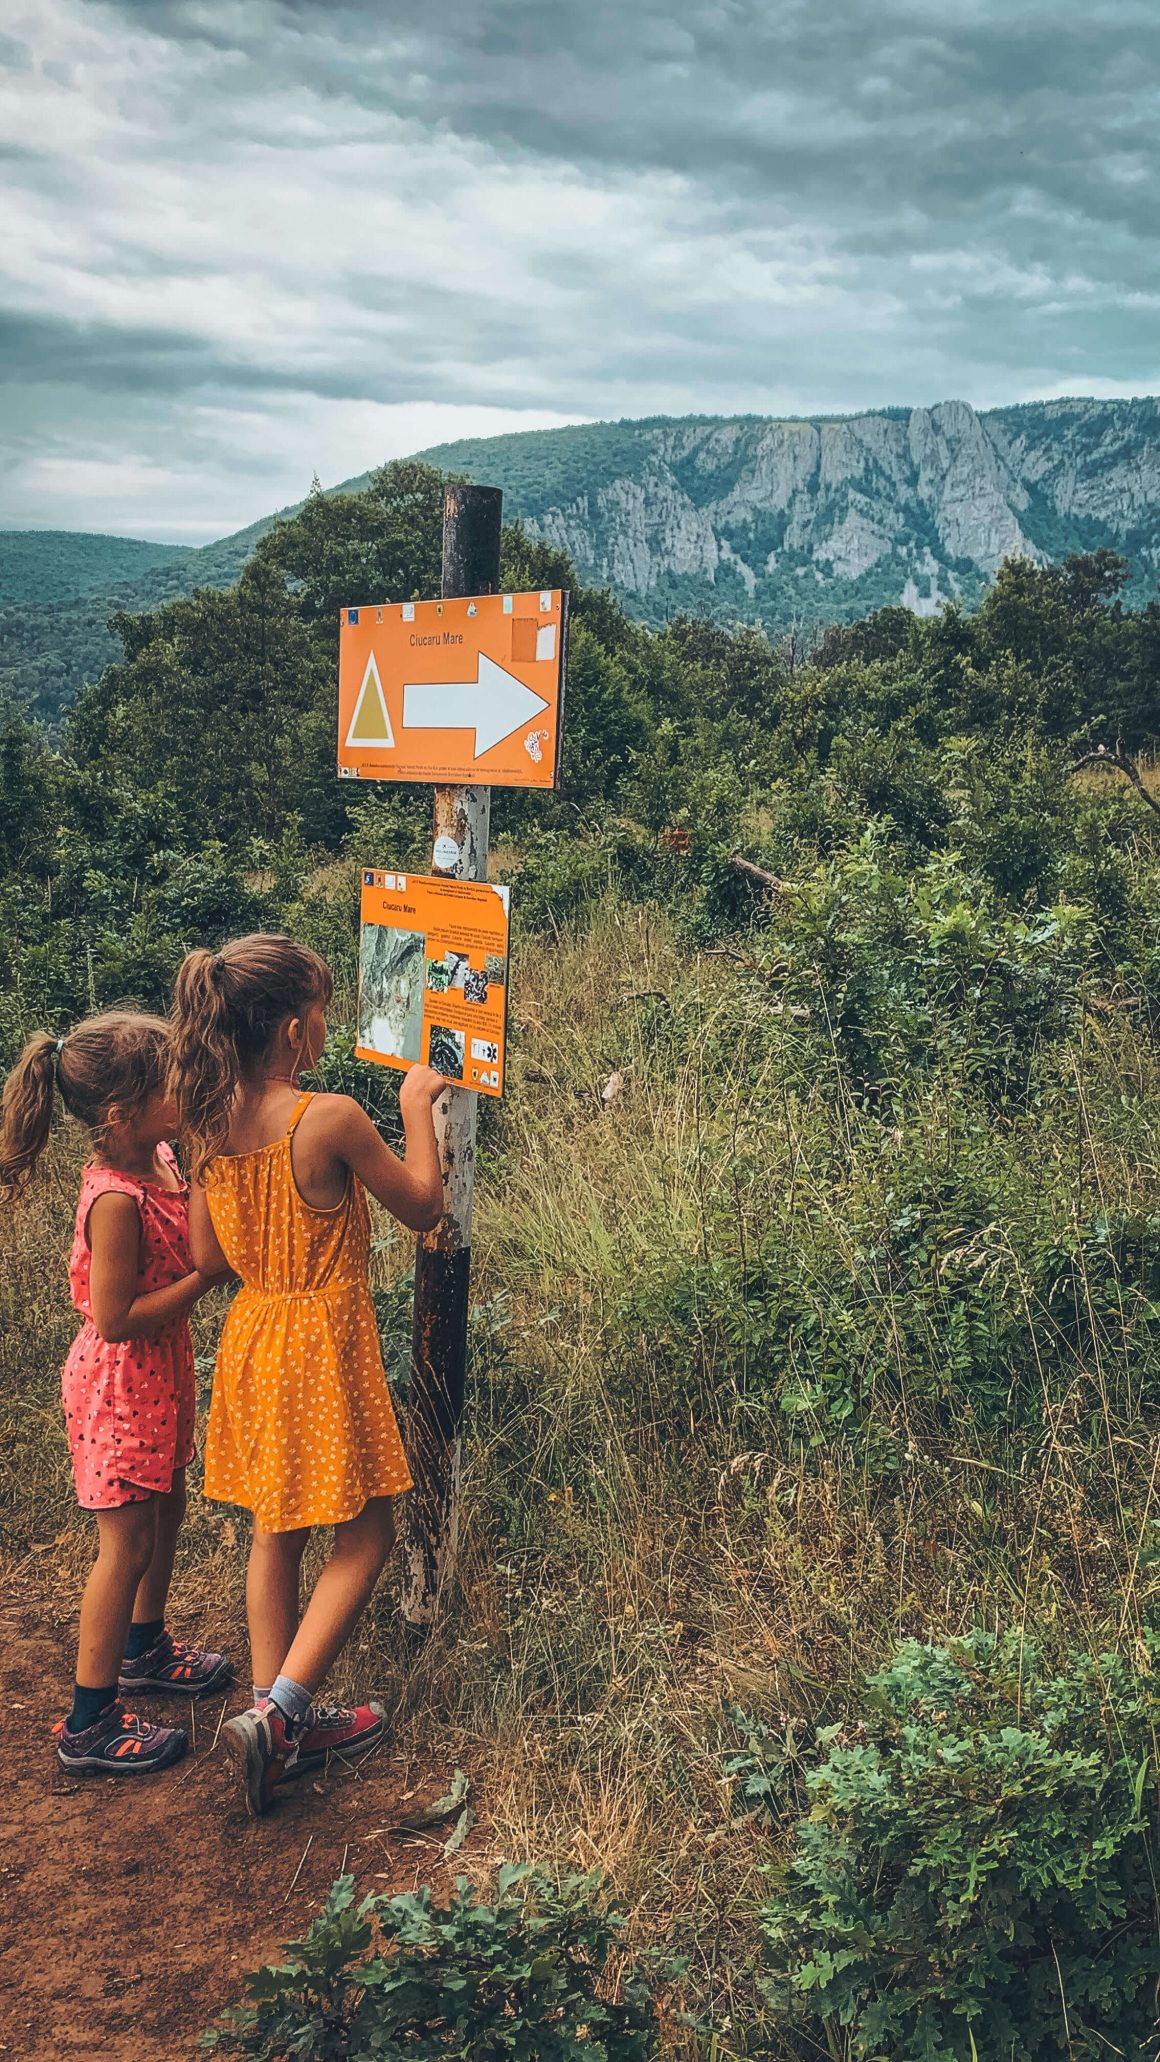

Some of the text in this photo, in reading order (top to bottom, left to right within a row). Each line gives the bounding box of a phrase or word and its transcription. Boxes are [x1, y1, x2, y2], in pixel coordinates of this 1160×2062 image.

[410, 632, 464, 646] Ciucaru Mare
[382, 901, 416, 914] Ciucaru Mare
